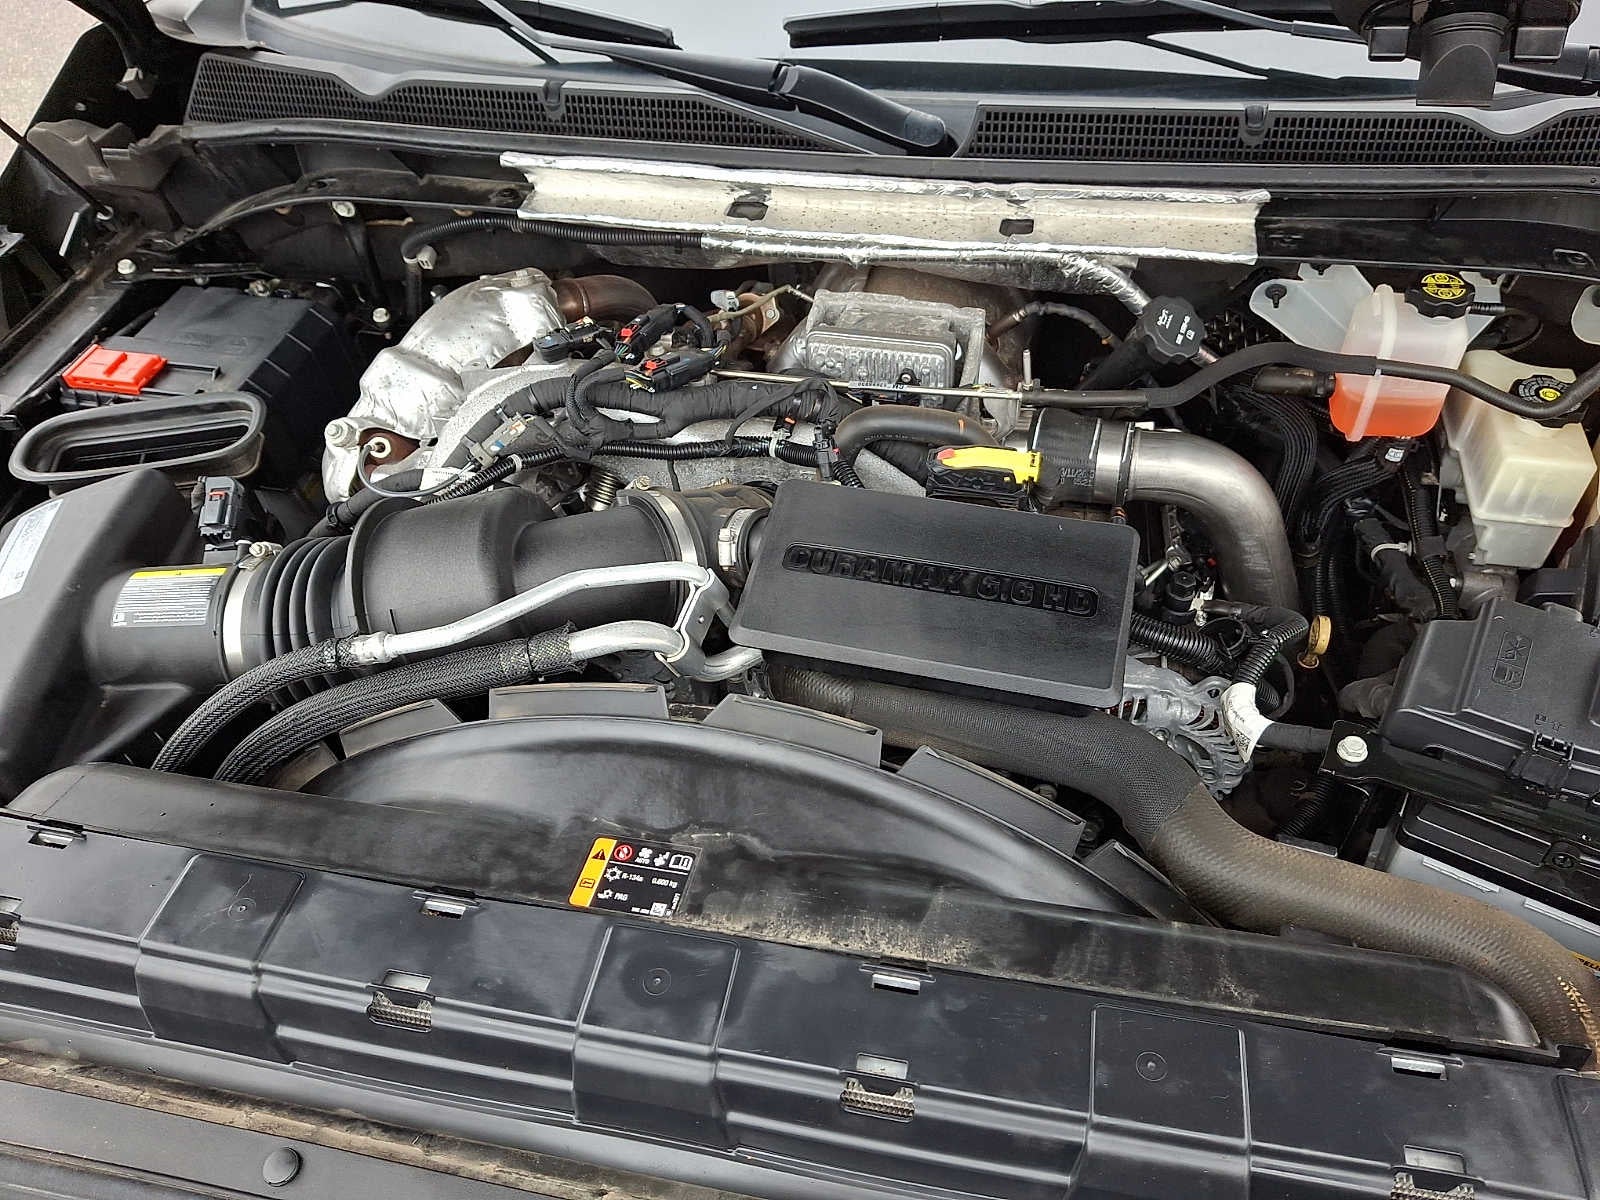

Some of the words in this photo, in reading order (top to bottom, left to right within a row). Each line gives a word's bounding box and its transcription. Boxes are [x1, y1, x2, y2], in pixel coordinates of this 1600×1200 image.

[785, 547, 967, 594] DURAMAX
[1042, 581, 1095, 615] HD
[634, 856, 650, 865] AUTO
[613, 892, 629, 902] PAG
